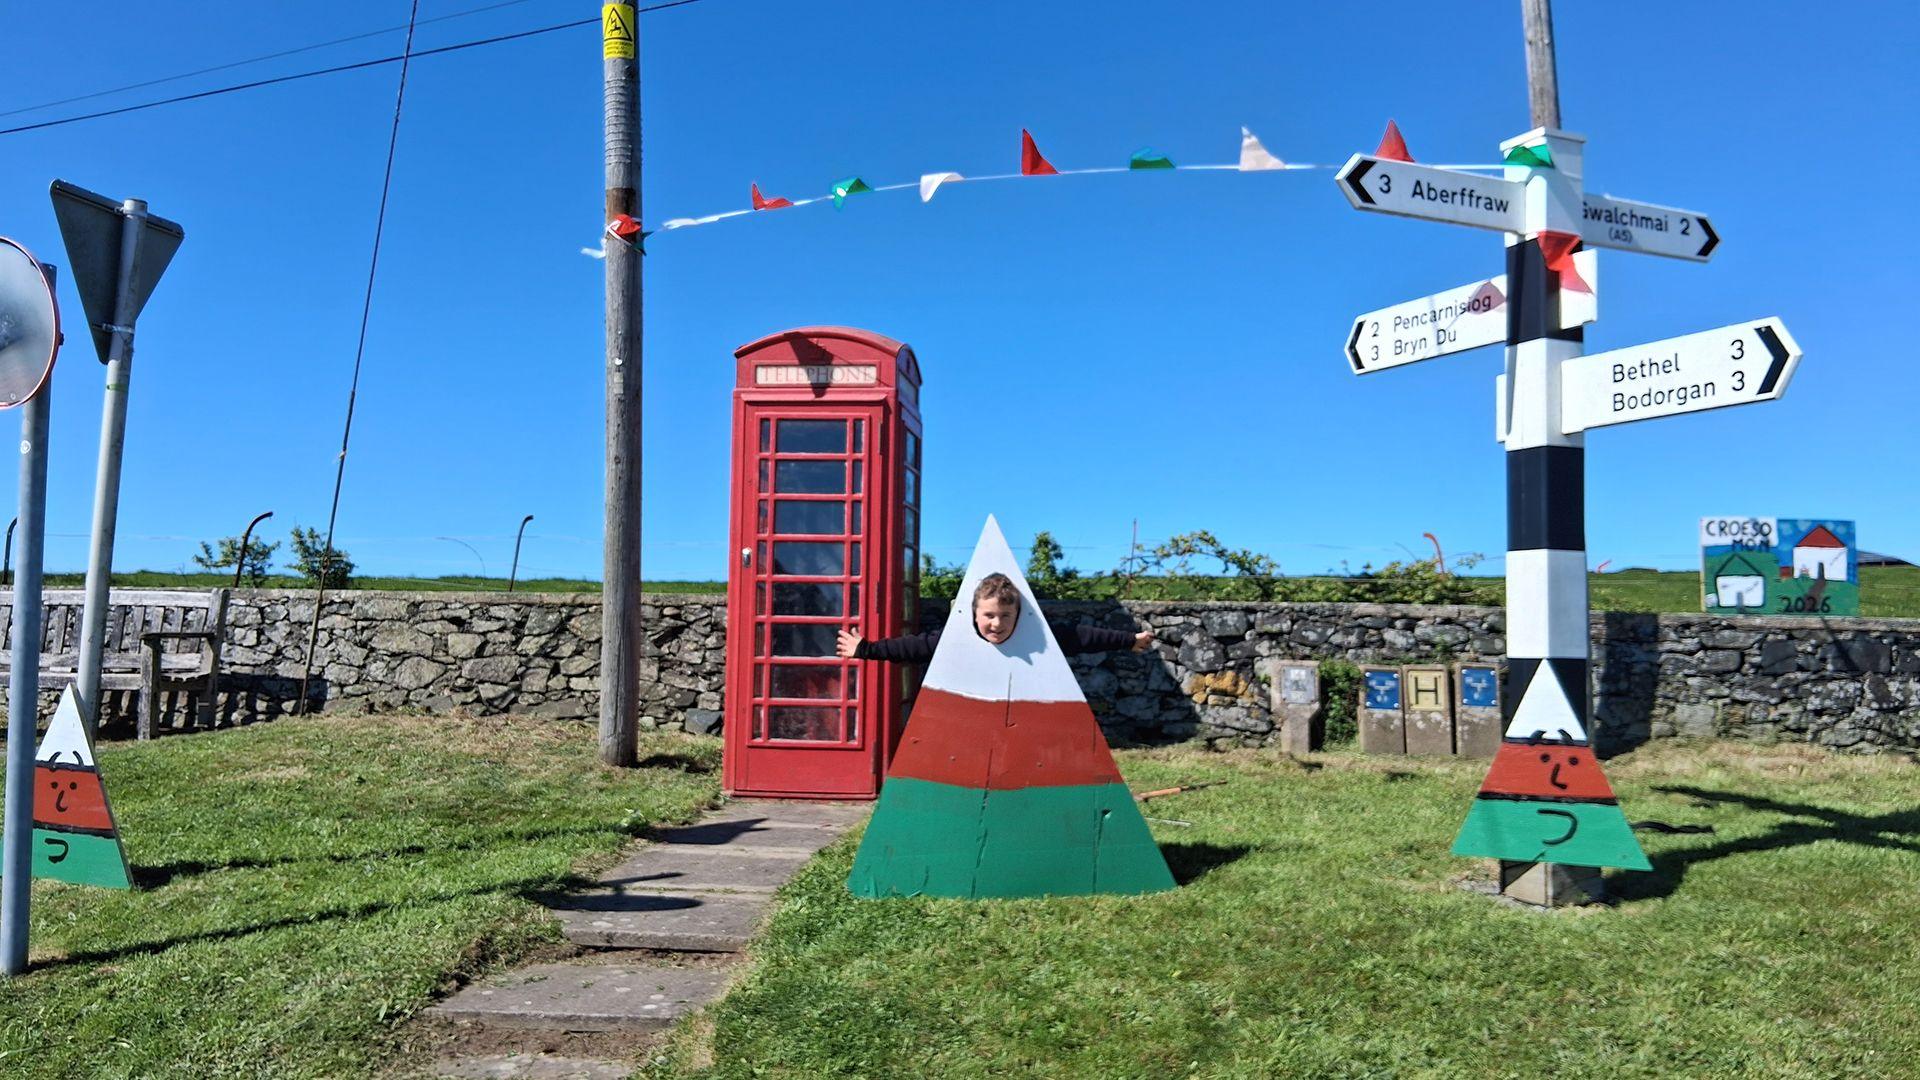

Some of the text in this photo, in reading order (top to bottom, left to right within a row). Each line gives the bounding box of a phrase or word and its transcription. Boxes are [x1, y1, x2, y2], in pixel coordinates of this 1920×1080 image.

[1378, 173, 1511, 214] 3 Aberffraw
[1679, 218, 1691, 236] 2
[1371, 294, 1492, 339] 2 Pencarnisiog
[1371, 328, 1457, 362] 3 Bryn Du
[760, 366, 875, 383] TELEPHONE
[1612, 339, 1745, 384] Bethel 3
[1613, 370, 1746, 413] Bodorgan 3
[1705, 519, 1772, 537] CROESO
[1781, 596, 1832, 614] 2026
[1414, 676, 1439, 705] H
